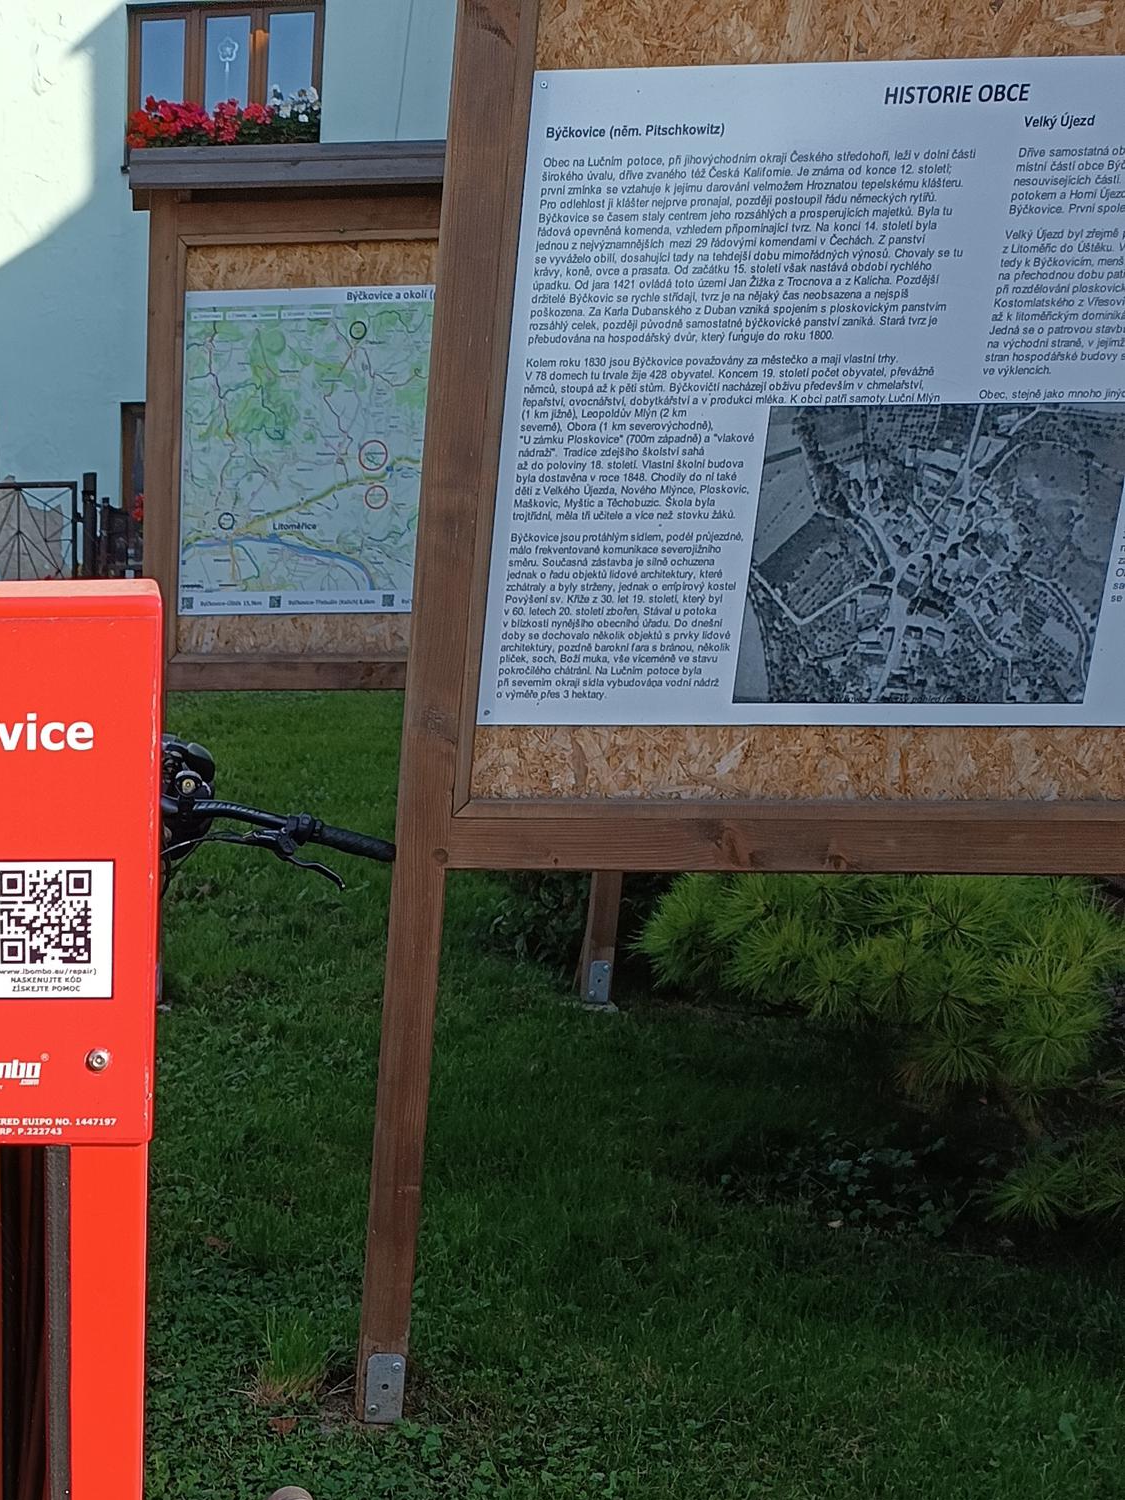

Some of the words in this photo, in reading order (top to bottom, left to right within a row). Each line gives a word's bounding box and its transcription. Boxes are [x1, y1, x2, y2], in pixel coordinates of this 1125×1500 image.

[884, 85, 972, 104] HISTORIE
[977, 84, 1029, 102] OBCE
[1022, 115, 1060, 129] Velký
[1058, 112, 1096, 129] Újezd
[545, 125, 609, 140] Býčkovice
[608, 125, 644, 139] (něm.
[644, 124, 725, 138] Pitschkowitz)
[543, 156, 570, 166] Obec
[587, 155, 623, 165] Lučním
[626, 155, 665, 167] potoce,
[789, 150, 834, 162] Českého
[541, 170, 584, 180] širokého
[586, 169, 616, 181] úvalu,
[645, 168, 687, 178] zvaného
[690, 168, 706, 178] též
[707, 166, 740, 177] Česká
[796, 167, 810, 176] Je
[811, 166, 845, 176] známa
[847, 166, 862, 175] od
[864, 165, 897, 175] konce
[900, 165, 915, 174] 12.
[1012, 174, 1092, 188] nesouvisejících
[539, 199, 557, 208] Pro
[559, 198, 605, 208] odlehlost
[616, 197, 649, 207] klášter
[650, 197, 688, 209] nejprve
[689, 196, 732, 208] pronajal,
[735, 195, 772, 208] později
[774, 195, 822, 207] postoupil
[824, 194, 848, 204] řádu
[849, 193, 907, 206] německých
[538, 212, 590, 224] Býčkovice
[606, 211, 639, 221] časem
[641, 211, 665, 223] staly
[667, 211, 707, 220] centrem
[709, 210, 731, 222] jeho
[733, 209, 788, 222] rozsáhlých
[871, 206, 914, 220] majetků.
[916, 207, 940, 219] Byla
[942, 208, 952, 216] tu
[535, 240, 569, 251] jednou
[695, 238, 708, 247] 29
[828, 234, 877, 245] Čechách.
[877, 236, 886, 245] Z
[1059, 243, 1074, 252] do
[347, 290, 393, 302] Býčkovice
[403, 290, 427, 299] okolí
[526, 357, 557, 366] Kolem
[558, 357, 581, 366] roku
[581, 357, 606, 366] 1830
[608, 356, 630, 368] jsou
[632, 356, 683, 368] Býčkovice
[684, 355, 744, 367] považovány
[760, 355, 809, 364] městečko
[842, 354, 876, 364] vlastní
[876, 354, 899, 366] trhy.
[521, 409, 530, 420] (1
[533, 409, 549, 418] km
[580, 407, 632, 420] Leopoldův
[658, 408, 670, 419] (2
[671, 408, 687, 417] km
[517, 460, 528, 469] až
[530, 460, 544, 469] do
[545, 460, 587, 471] poloviny
[590, 460, 604, 469] 18.
[640, 459, 674, 468] Vlastní
[676, 459, 705, 468] školní
[707, 459, 744, 468] budova
[509, 545, 532, 553] málo
[602, 545, 659, 553] komunikace
[528, 607, 556, 615] letech
[558, 607, 572, 615] 20.
[575, 606, 604, 615] století
[642, 606, 672, 615] Stával
[682, 606, 717, 617] potoka
